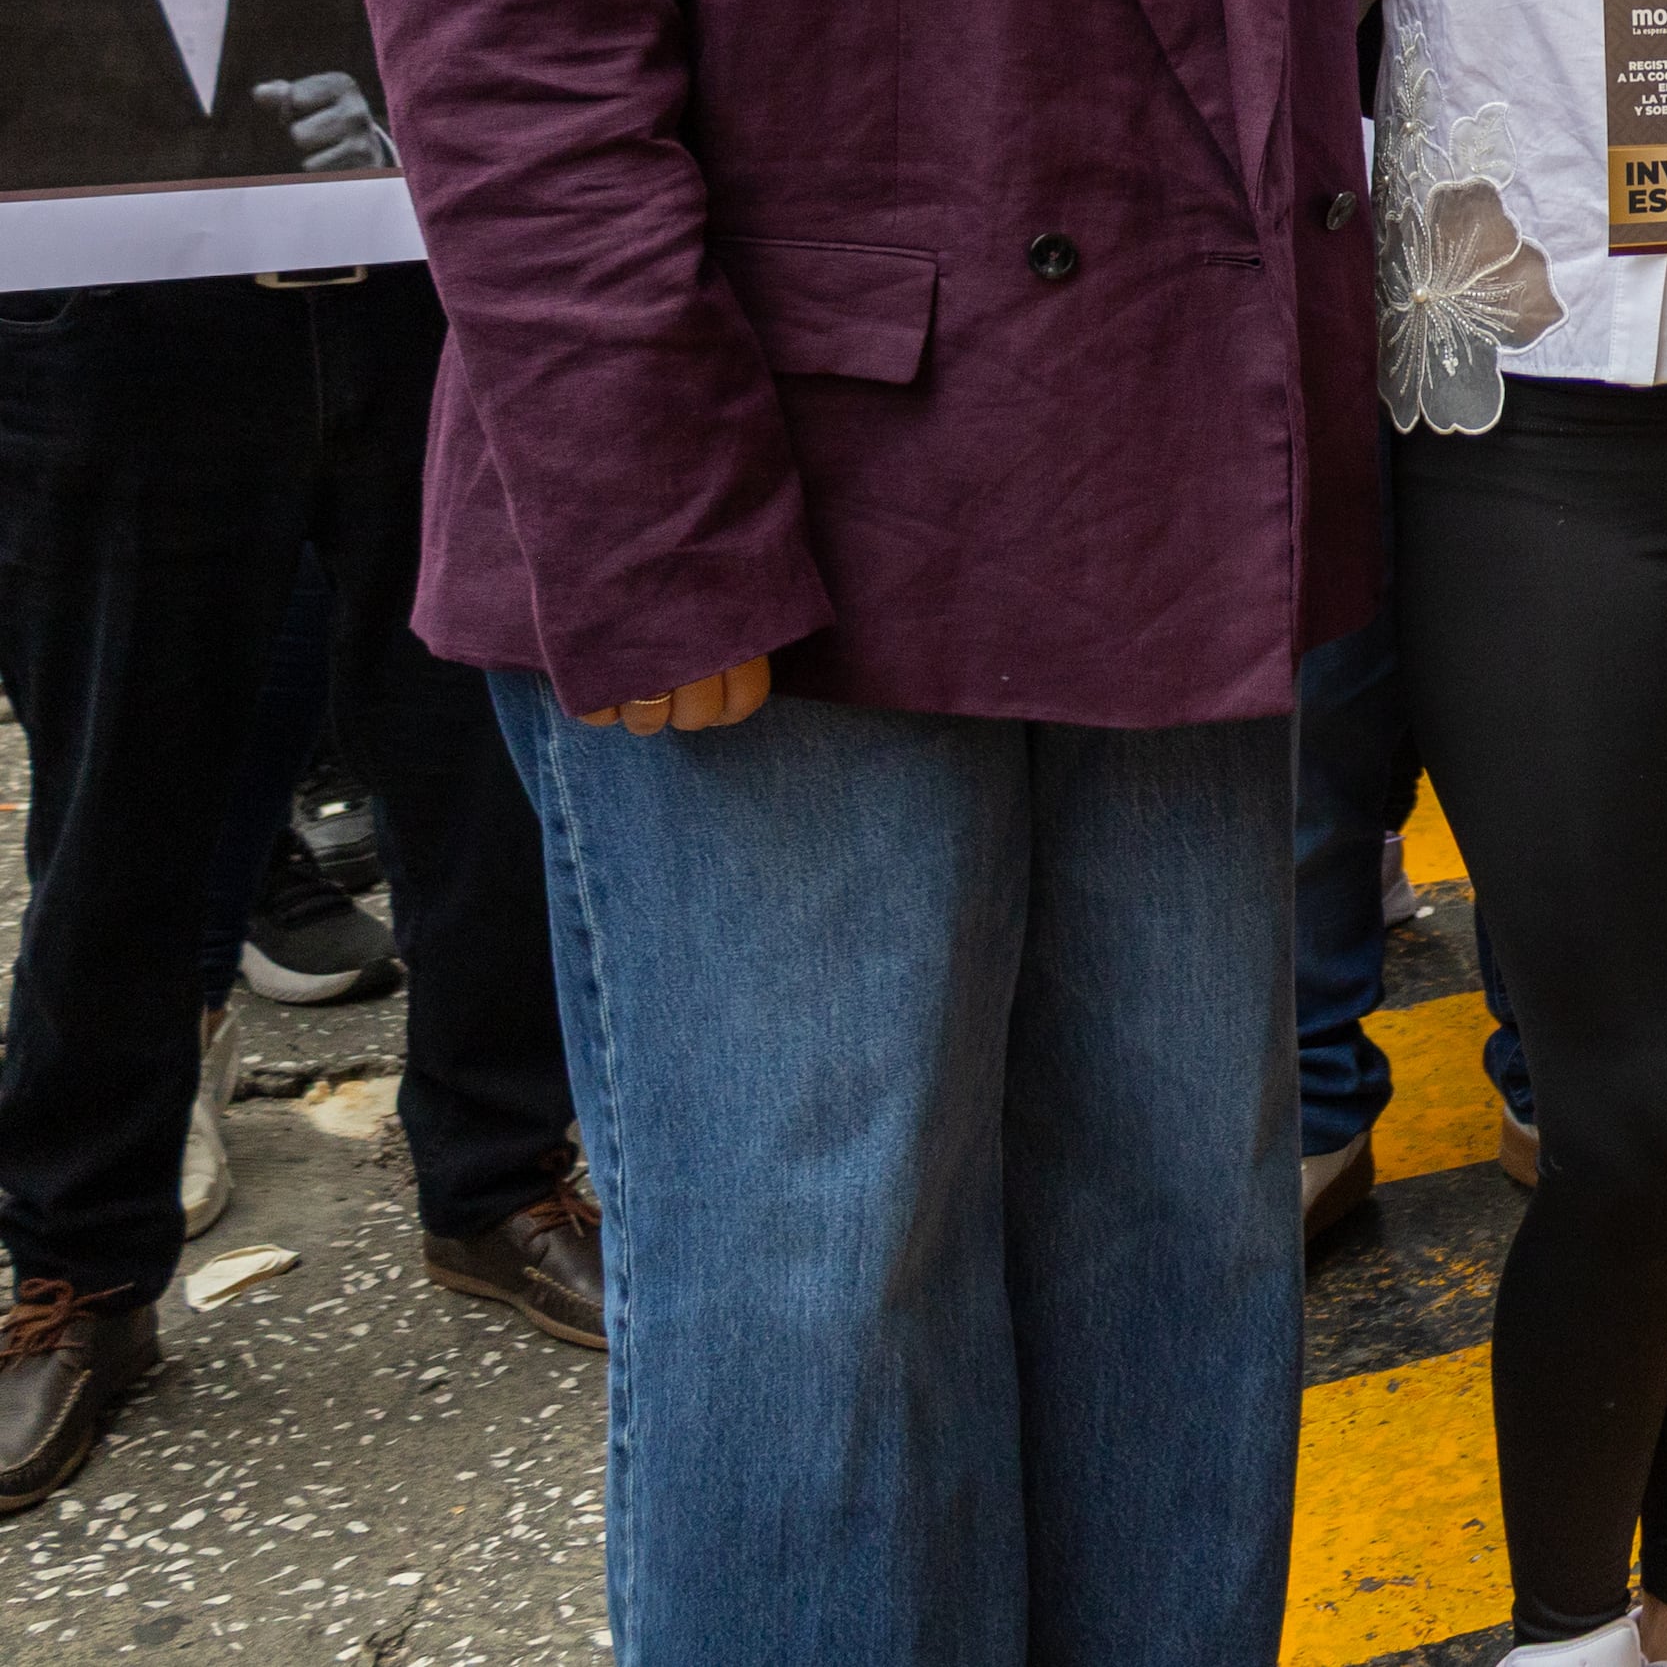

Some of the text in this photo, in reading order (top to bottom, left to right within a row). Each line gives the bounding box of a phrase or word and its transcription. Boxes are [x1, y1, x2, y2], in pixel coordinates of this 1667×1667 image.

[1617, 73, 1627, 83] A
[1629, 72, 1645, 82] LA
[1642, 94, 1658, 104] LA
[1634, 106, 1643, 116] Y
